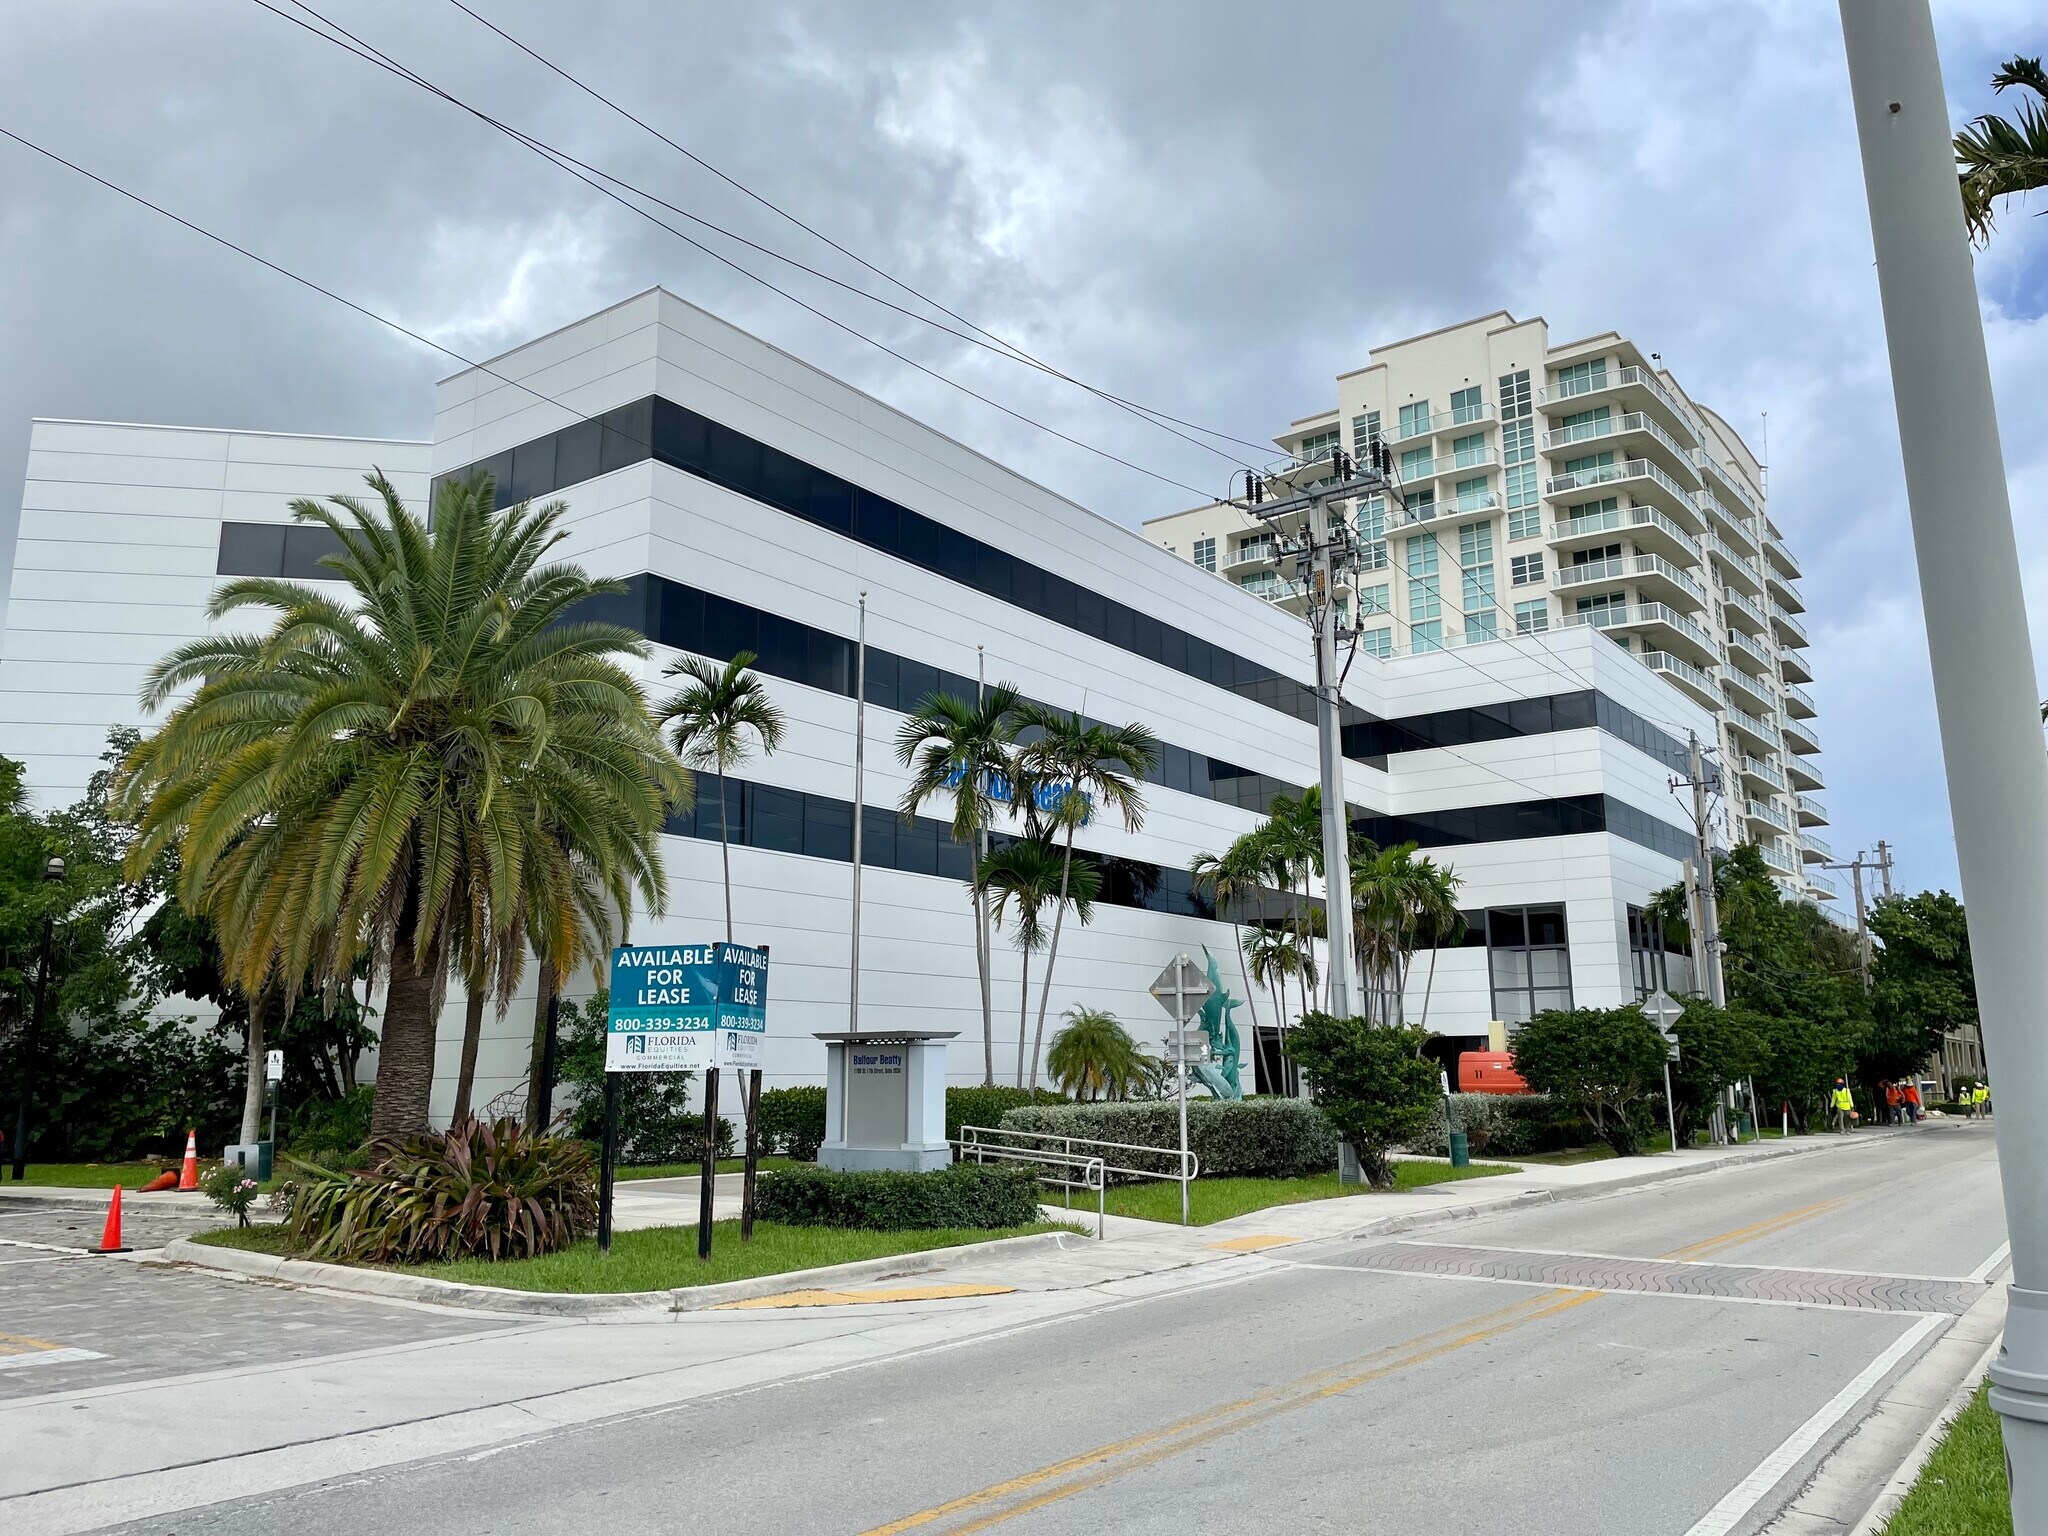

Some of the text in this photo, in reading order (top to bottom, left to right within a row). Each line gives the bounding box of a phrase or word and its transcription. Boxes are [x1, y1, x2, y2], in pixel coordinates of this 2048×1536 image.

[617, 949, 714, 968] AVAILABLE
[723, 947, 767, 970] AVAILABLE
[647, 969, 683, 986] FOR
[740, 969, 756, 987] FOR
[638, 988, 690, 1005] LEASE
[734, 987, 758, 1005] LEASE
[614, 1016, 710, 1031] 800-339-3234
[720, 1014, 764, 1031] 800-339-3234
[647, 1036, 697, 1046] FLORIDA
[620, 1062, 701, 1070] www.FloridaEquities.net
[853, 1054, 902, 1066] Balfour Beatty
[1474, 1069, 1483, 1079] 11
